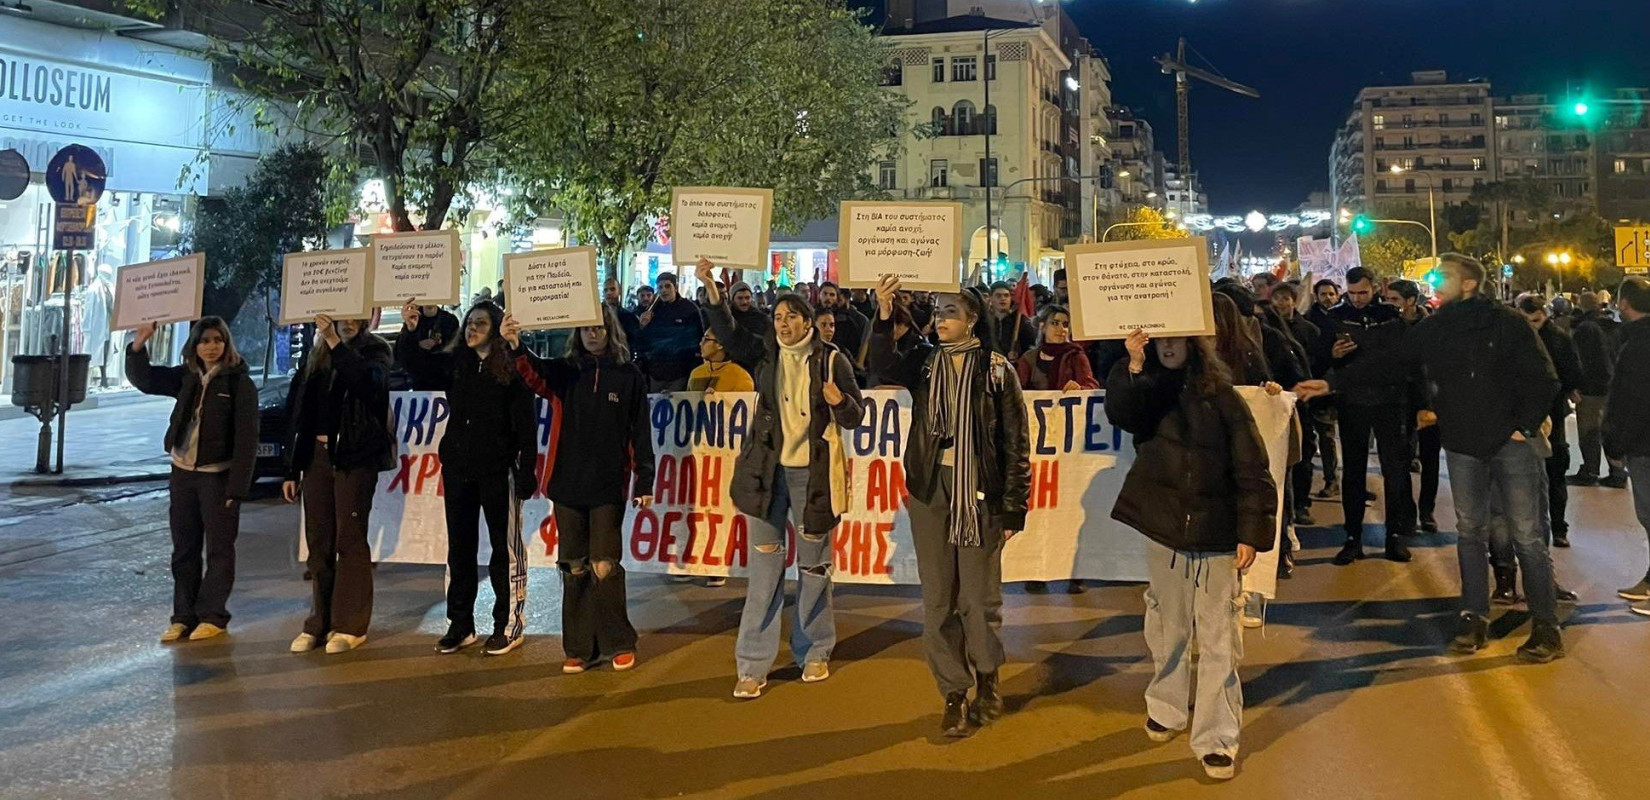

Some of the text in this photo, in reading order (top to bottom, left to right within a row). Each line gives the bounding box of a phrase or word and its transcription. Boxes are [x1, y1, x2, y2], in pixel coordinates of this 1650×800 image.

[3, 114, 81, 130] GET THE LOOK
[689, 199, 703, 207] όπλο
[717, 201, 756, 209] συστήματος
[856, 213, 870, 221] Στη
[900, 212, 946, 221] συστήματος
[691, 220, 708, 229] καμία
[876, 224, 923, 233] καμία ανοχή,
[693, 231, 709, 239] καμία
[858, 235, 894, 244] οργάνωση
[910, 236, 940, 246] αγώνας
[878, 247, 933, 258] μόρφωση-ζωή!
[528, 259, 567, 270] Δώστε λεφτά
[1109, 260, 1140, 269] φτώχεια,
[1158, 257, 1177, 266] κρύο,
[547, 270, 571, 278] Παιδεία,
[1102, 272, 1129, 280] θάνατο,
[1150, 267, 1192, 276] καταστολή,
[518, 285, 526, 293] όχι
[528, 285, 536, 293] για
[538, 281, 571, 290] καταστολή
[1099, 282, 1134, 291] οργάνωση
[1149, 280, 1177, 288] αγώνας
[530, 293, 569, 303] τρομοκρατία!
[1134, 291, 1169, 299] ανατροπή
[853, 397, 901, 457] ΘΑ
